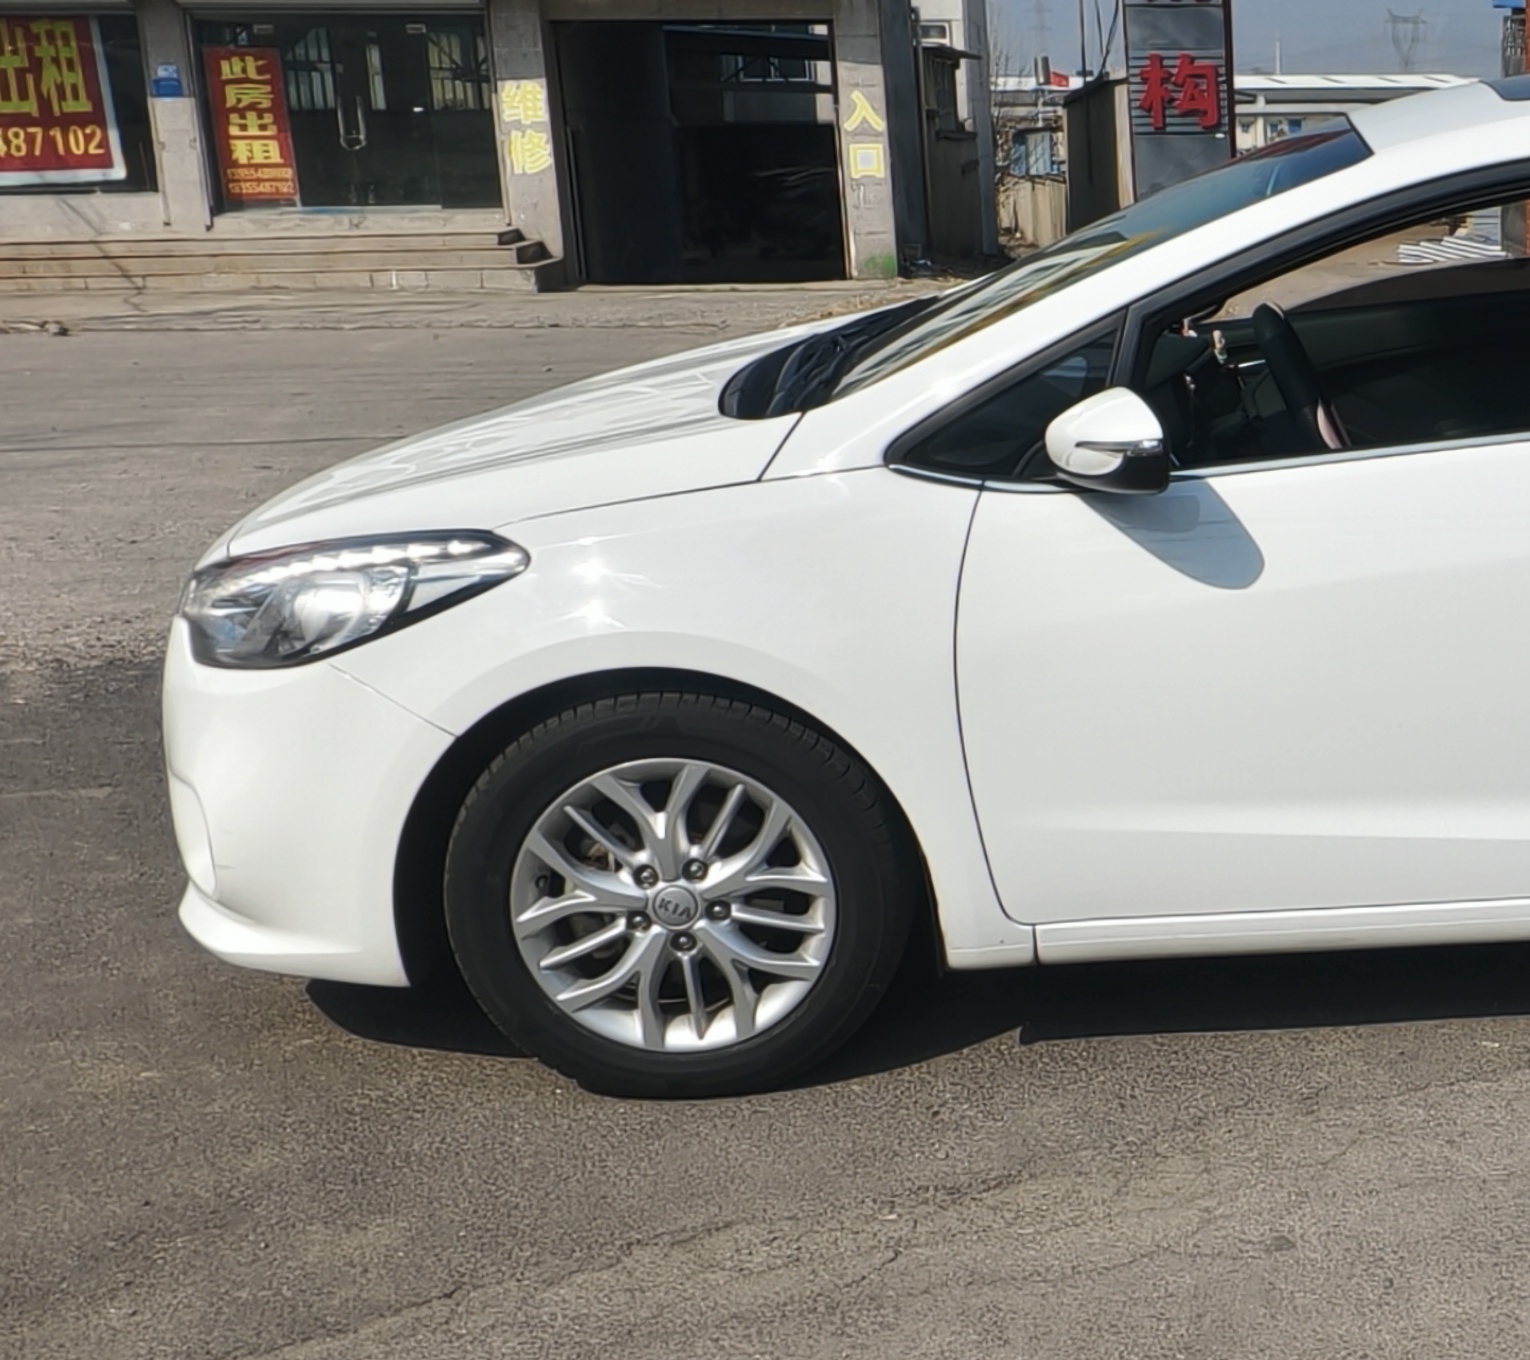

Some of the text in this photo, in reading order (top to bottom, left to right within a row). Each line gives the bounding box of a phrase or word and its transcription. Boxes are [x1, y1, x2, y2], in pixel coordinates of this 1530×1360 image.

[221, 56, 284, 164] 此房出租
[501, 79, 552, 175] 维修
[844, 90, 885, 179] 入口
[658, 897, 692, 920] KIA
